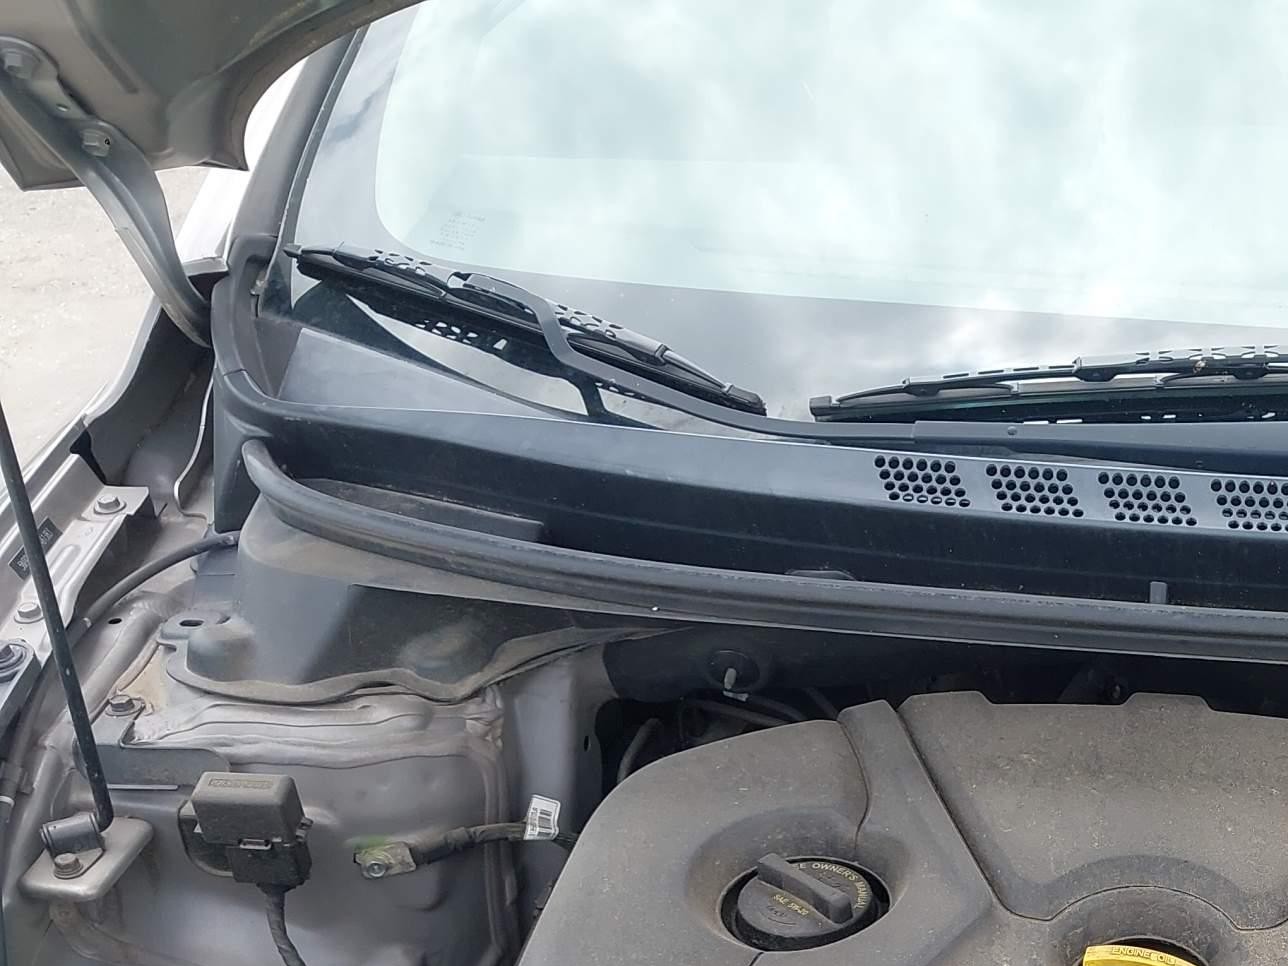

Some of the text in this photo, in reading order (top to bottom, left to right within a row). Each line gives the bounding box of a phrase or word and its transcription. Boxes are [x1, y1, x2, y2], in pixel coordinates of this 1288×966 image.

[812, 862, 858, 881] OWNER'S
[854, 881, 868, 909] MANUAL
[1111, 946, 1176, 966] ENGINE OIL
